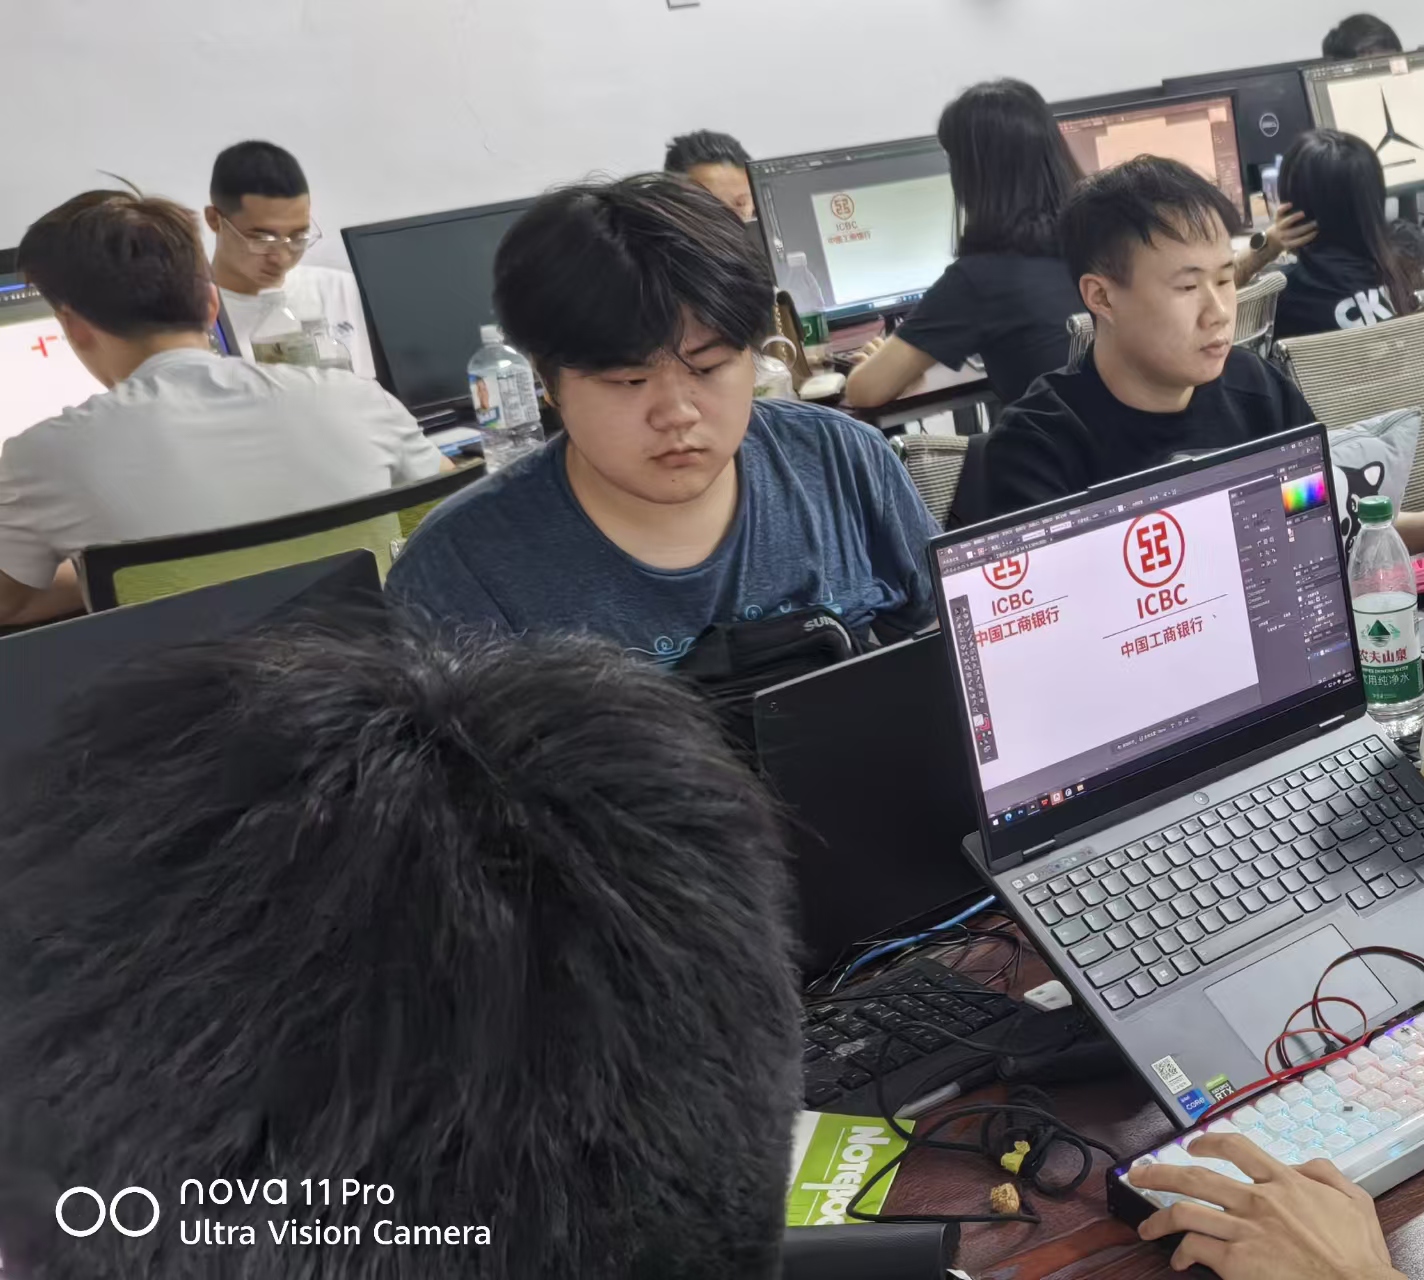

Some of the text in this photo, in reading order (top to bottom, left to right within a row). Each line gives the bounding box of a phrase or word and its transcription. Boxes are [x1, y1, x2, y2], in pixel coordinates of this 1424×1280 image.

[991, 589, 1034, 617] ICBC
[1136, 583, 1188, 619] ICBC
[974, 605, 1061, 648] 中国工商银行
[1120, 616, 1203, 658] 中国工商银行
[1214, 1086, 1235, 1101] RTX
